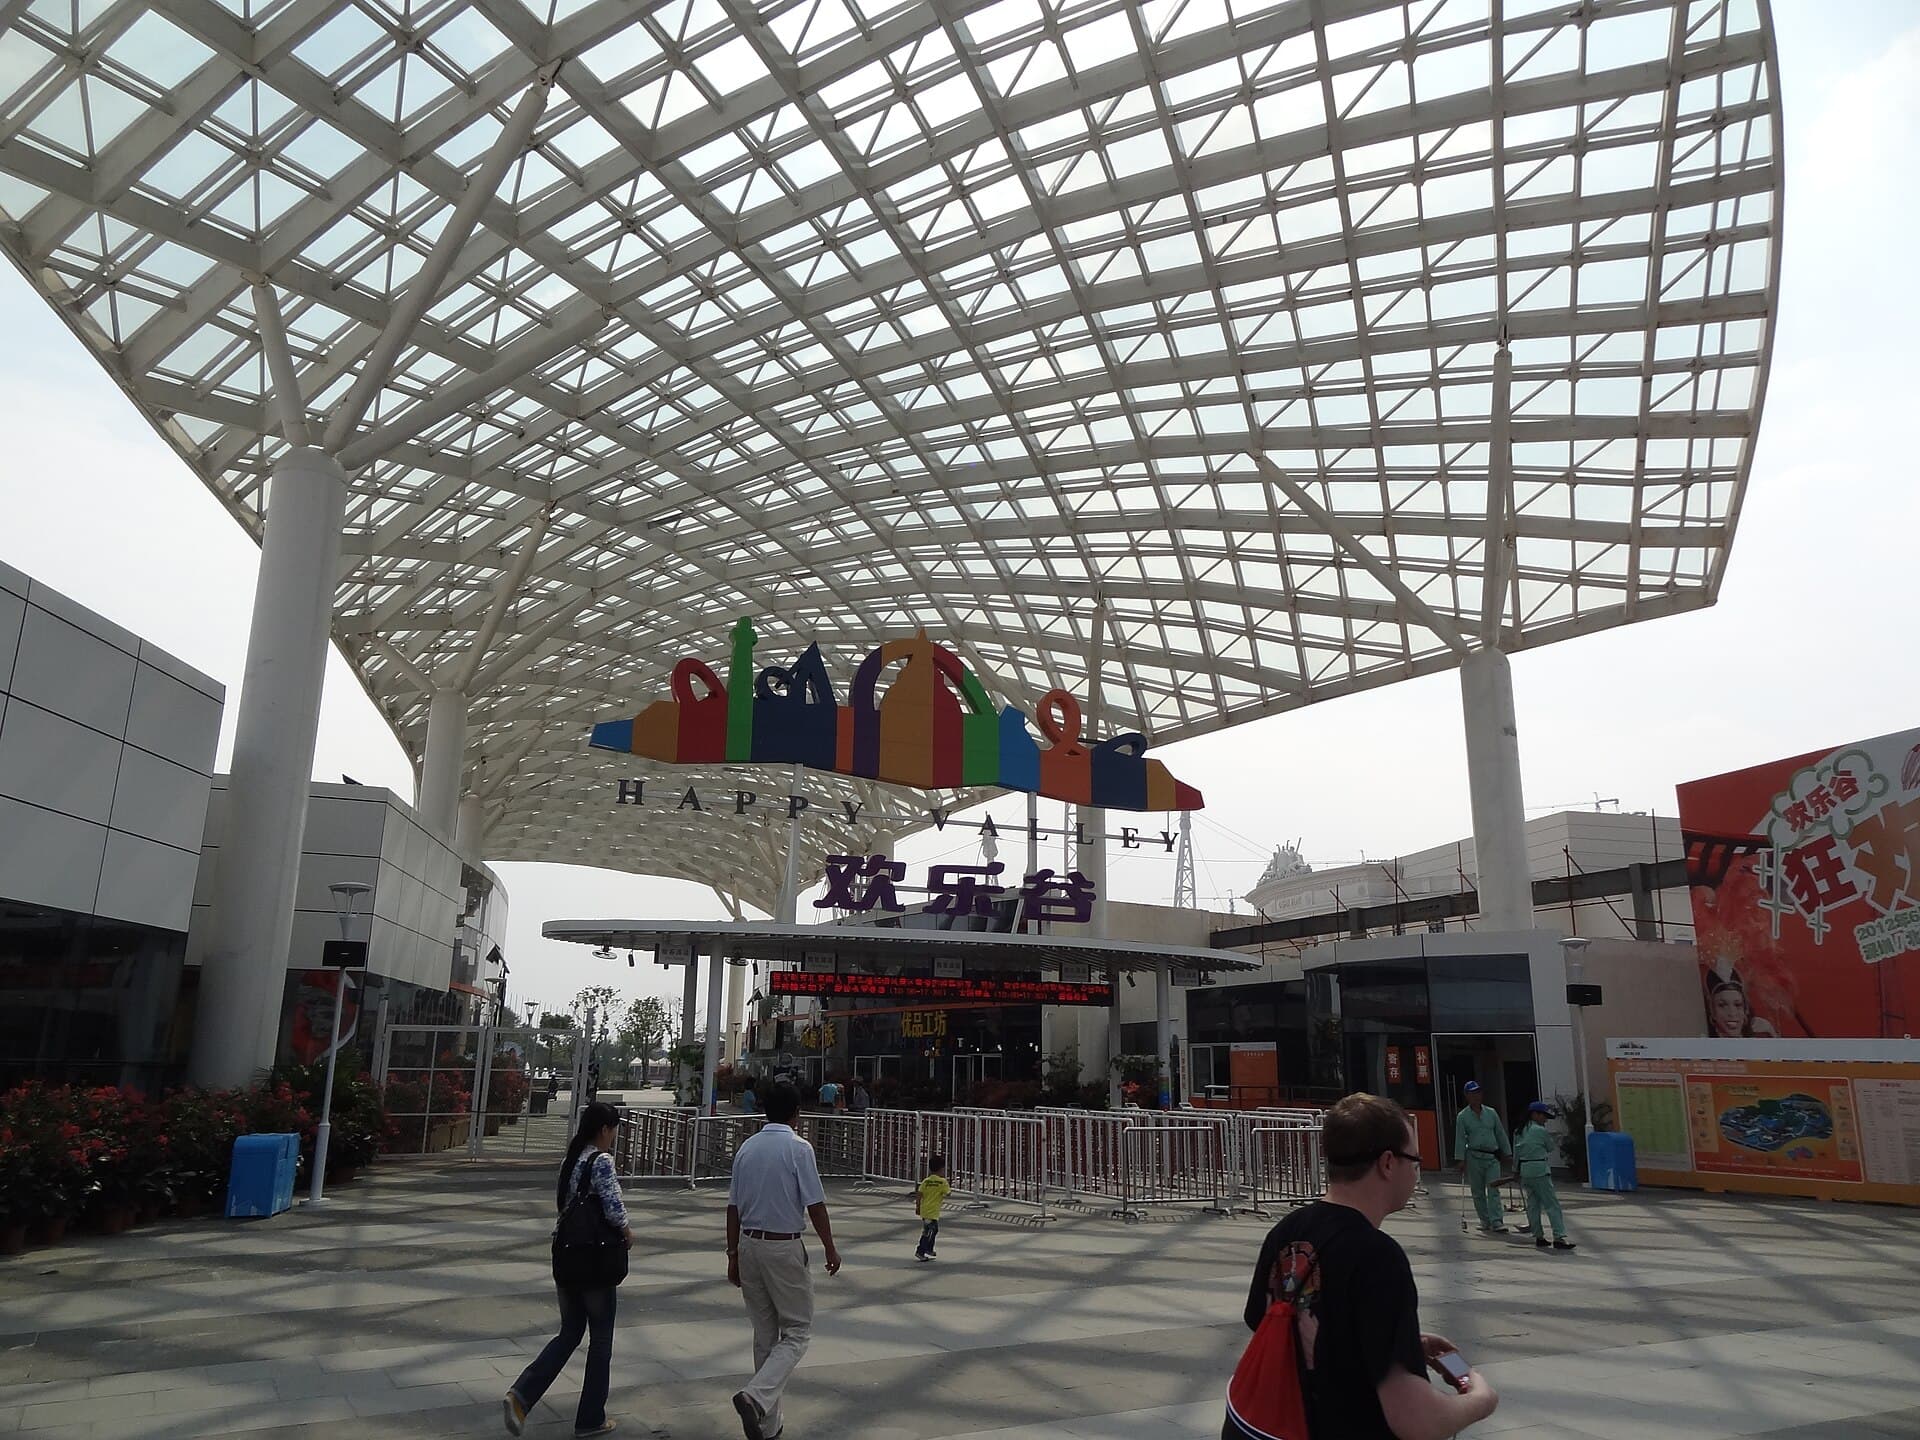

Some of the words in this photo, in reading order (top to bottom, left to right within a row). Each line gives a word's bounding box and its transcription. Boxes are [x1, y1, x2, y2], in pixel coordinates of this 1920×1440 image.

[616, 778, 864, 825] HAPPY
[930, 808, 1180, 853] VALLEY
[1782, 769, 1860, 833] 欢乐谷
[813, 853, 1097, 922] 欢乐谷
[1856, 905, 1920, 939] 2012年6
[900, 1010, 948, 1038] 优品工坊
